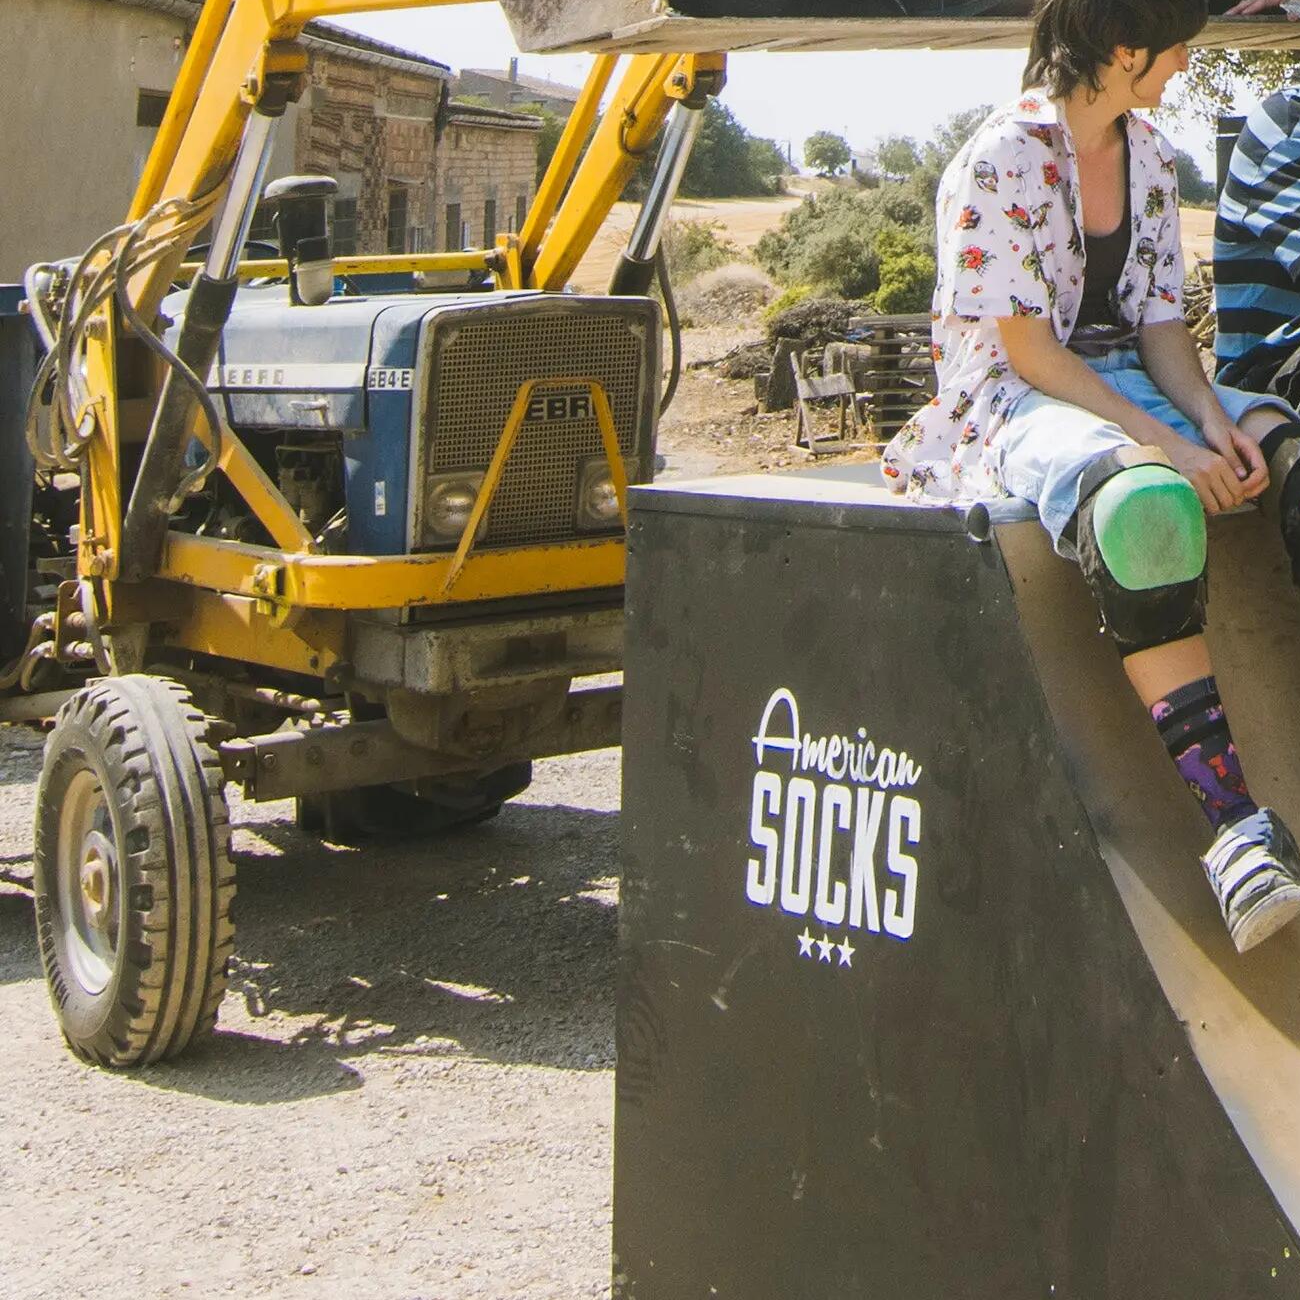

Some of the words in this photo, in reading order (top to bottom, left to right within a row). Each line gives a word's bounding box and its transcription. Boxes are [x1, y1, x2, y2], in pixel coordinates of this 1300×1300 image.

[526, 396, 613, 421] EBR
[752, 687, 922, 789] American
[745, 770, 921, 939] SOCKS
